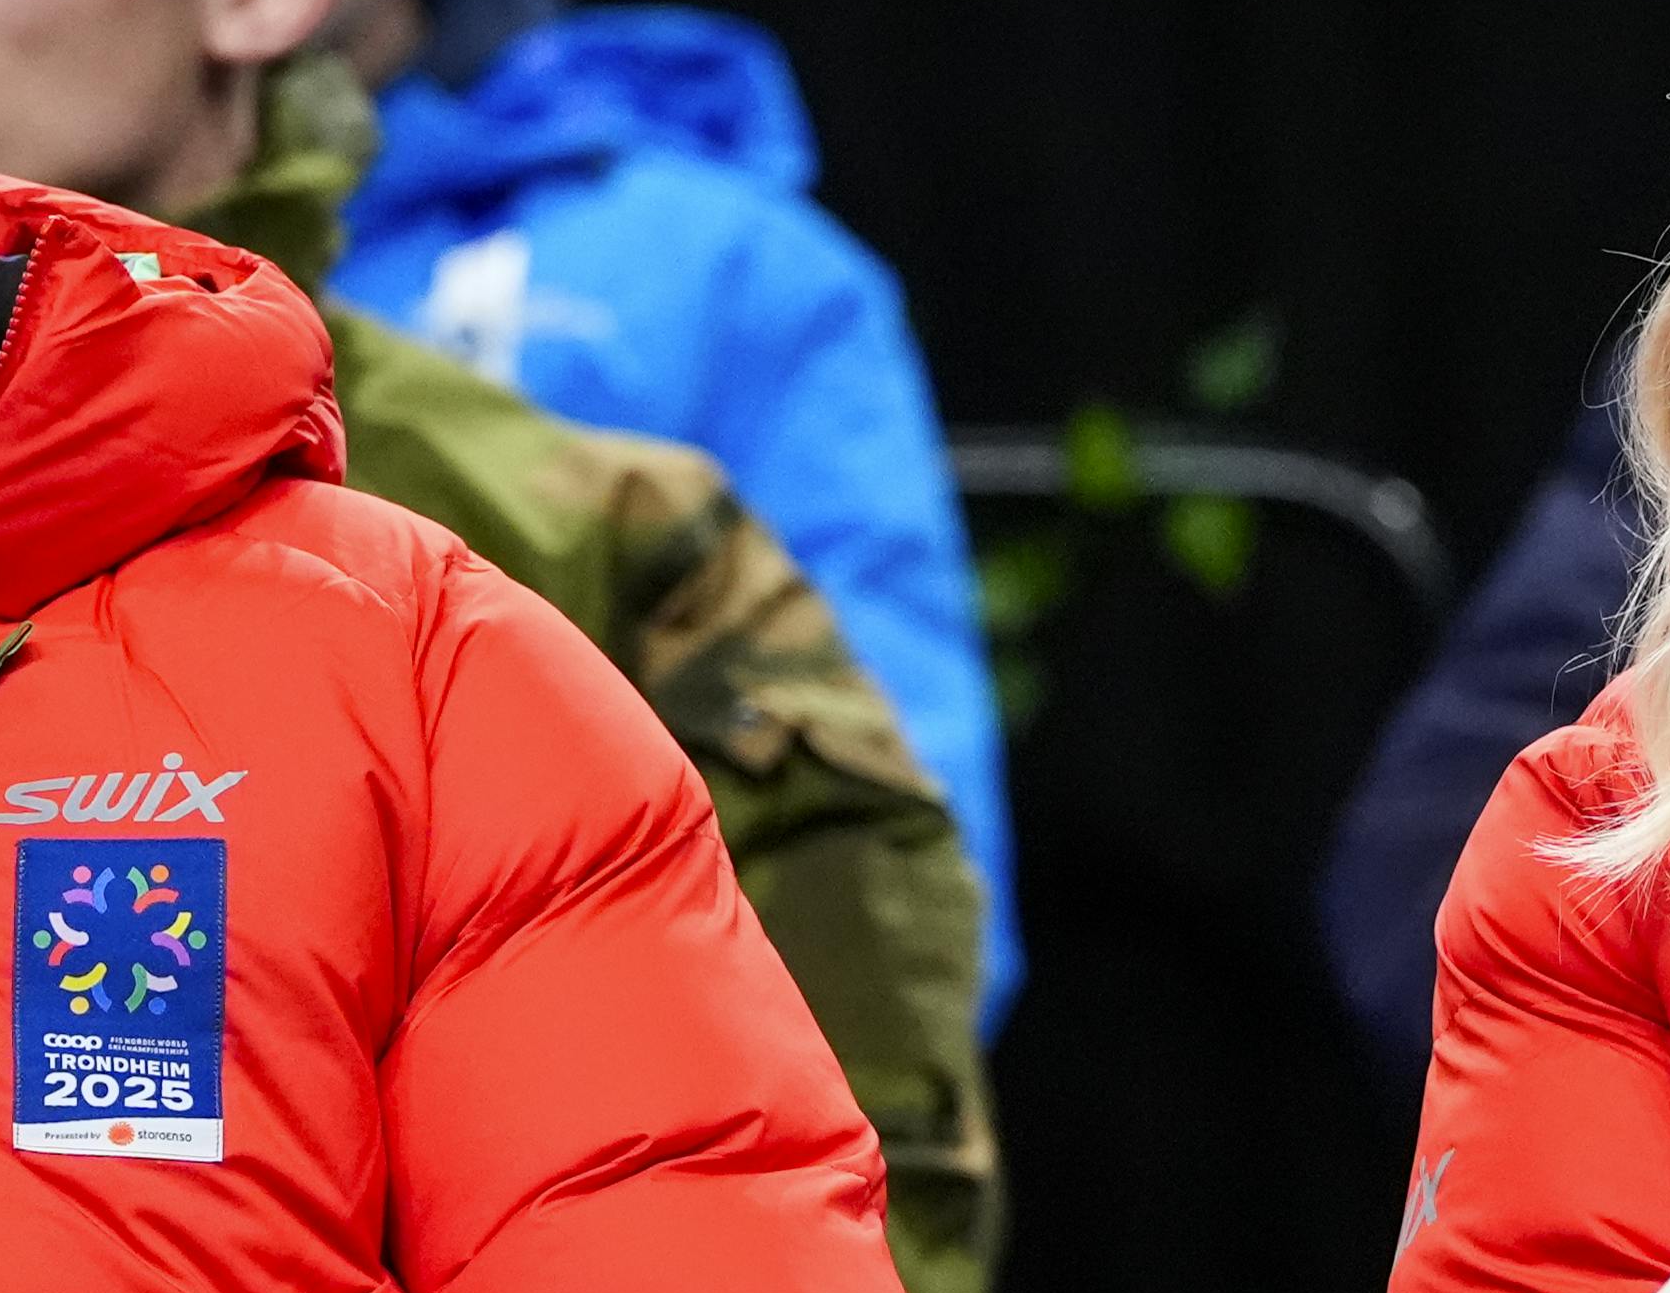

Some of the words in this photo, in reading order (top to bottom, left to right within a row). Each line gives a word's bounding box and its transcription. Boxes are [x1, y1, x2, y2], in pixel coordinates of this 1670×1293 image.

[44, 1052, 190, 1079] TRONDHEIM
[44, 1071, 194, 1112] 2025
[44, 1132, 88, 1140] Presented
[90, 1131, 102, 1140] by
